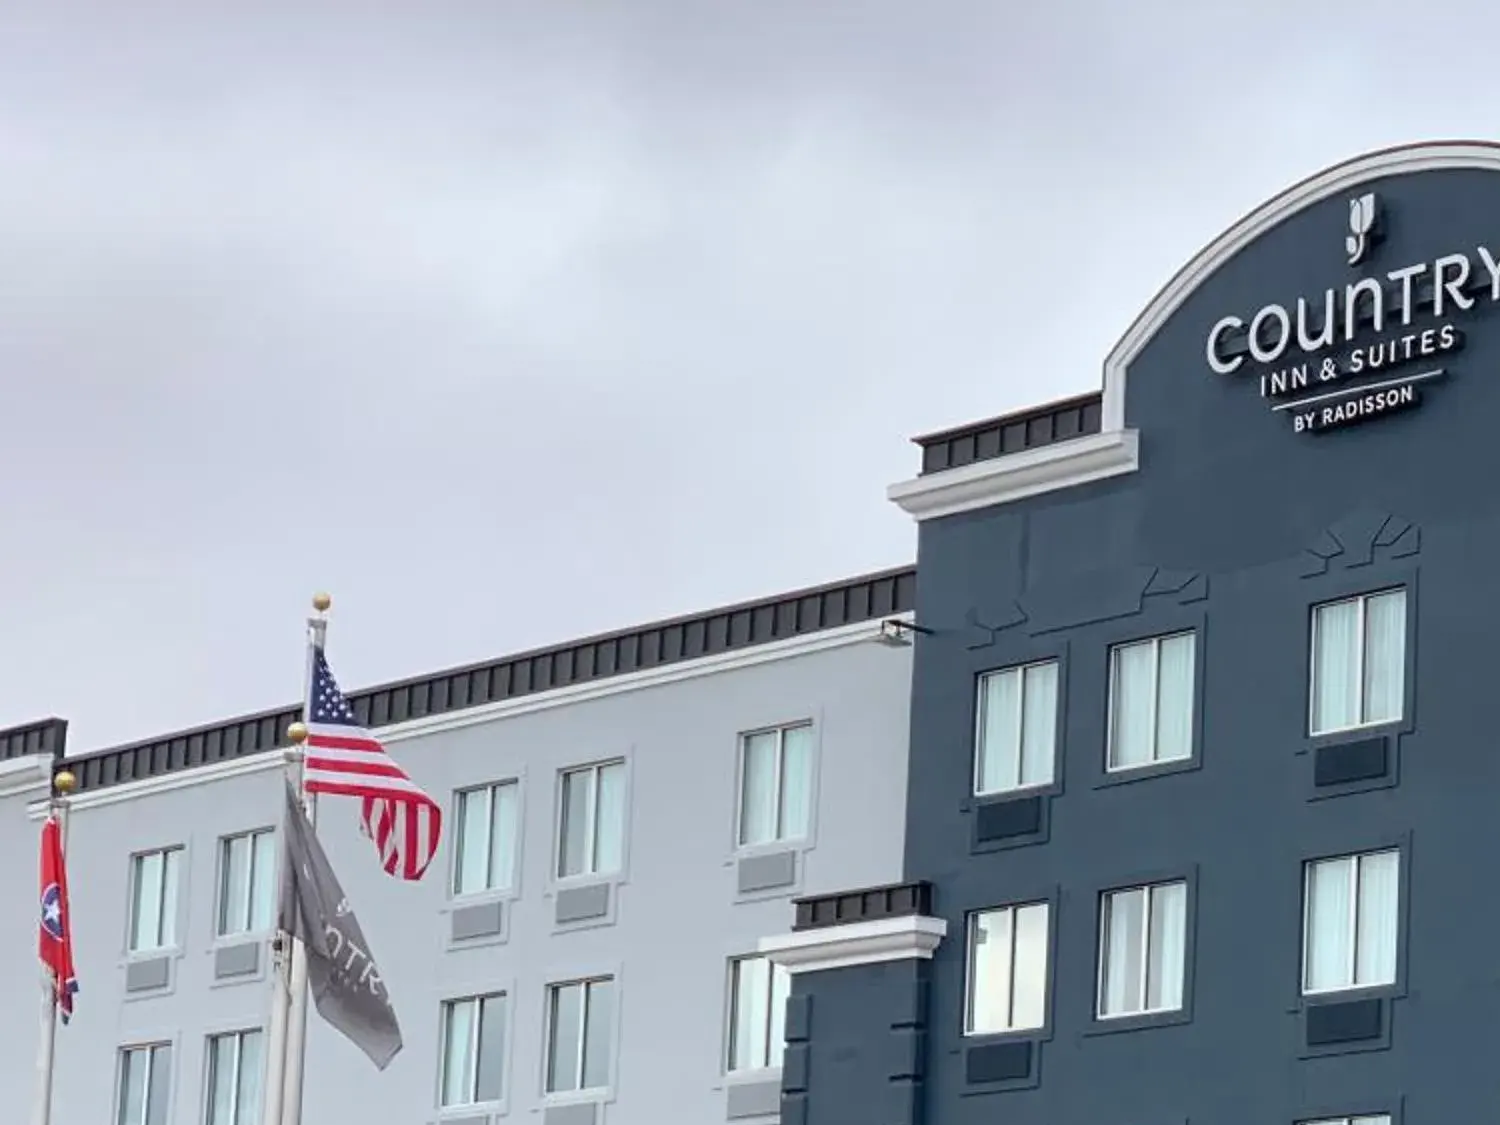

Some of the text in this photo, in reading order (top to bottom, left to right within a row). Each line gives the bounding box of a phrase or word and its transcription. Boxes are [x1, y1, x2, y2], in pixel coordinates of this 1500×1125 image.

[1260, 324, 1456, 397] INN & SUITES
[1293, 384, 1414, 433] BY RADISSON
